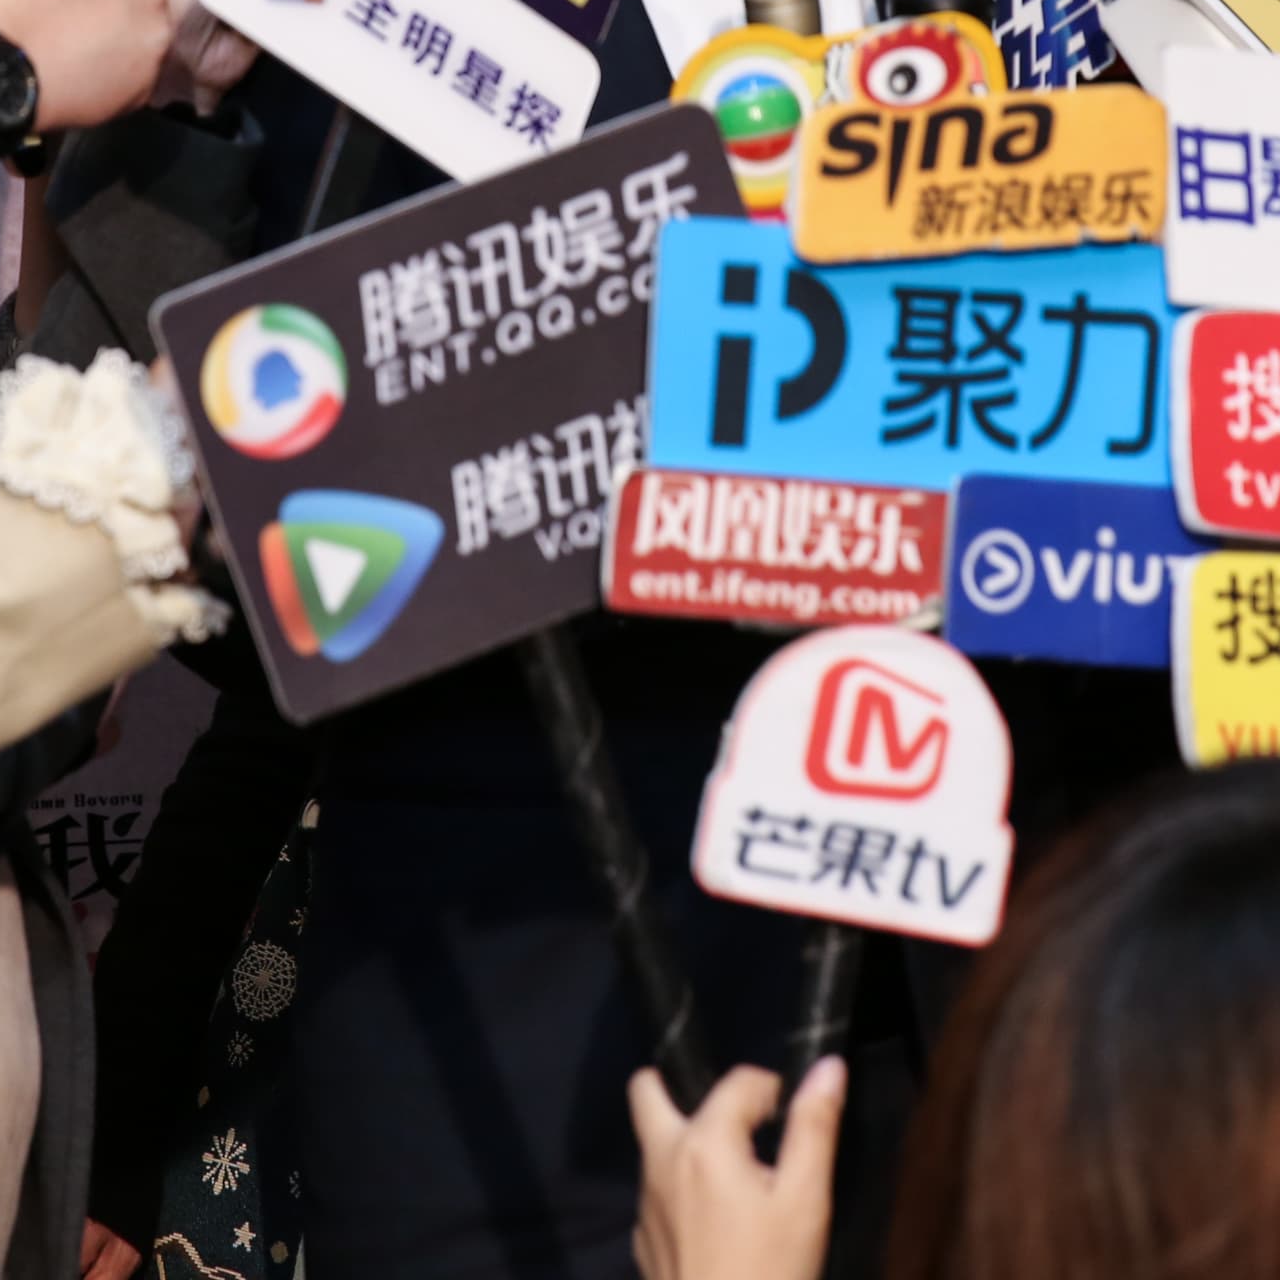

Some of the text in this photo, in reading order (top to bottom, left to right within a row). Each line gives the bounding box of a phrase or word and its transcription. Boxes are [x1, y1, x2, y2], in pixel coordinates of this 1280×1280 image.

[819, 101, 1057, 210] sina
[913, 169, 1155, 242] 新浪娱乐
[358, 151, 698, 367] 腾讯娱乐
[880, 285, 1161, 458] 聚力
[630, 567, 934, 620] ent.ifeng.com
[734, 804, 985, 910] 芒果tv
